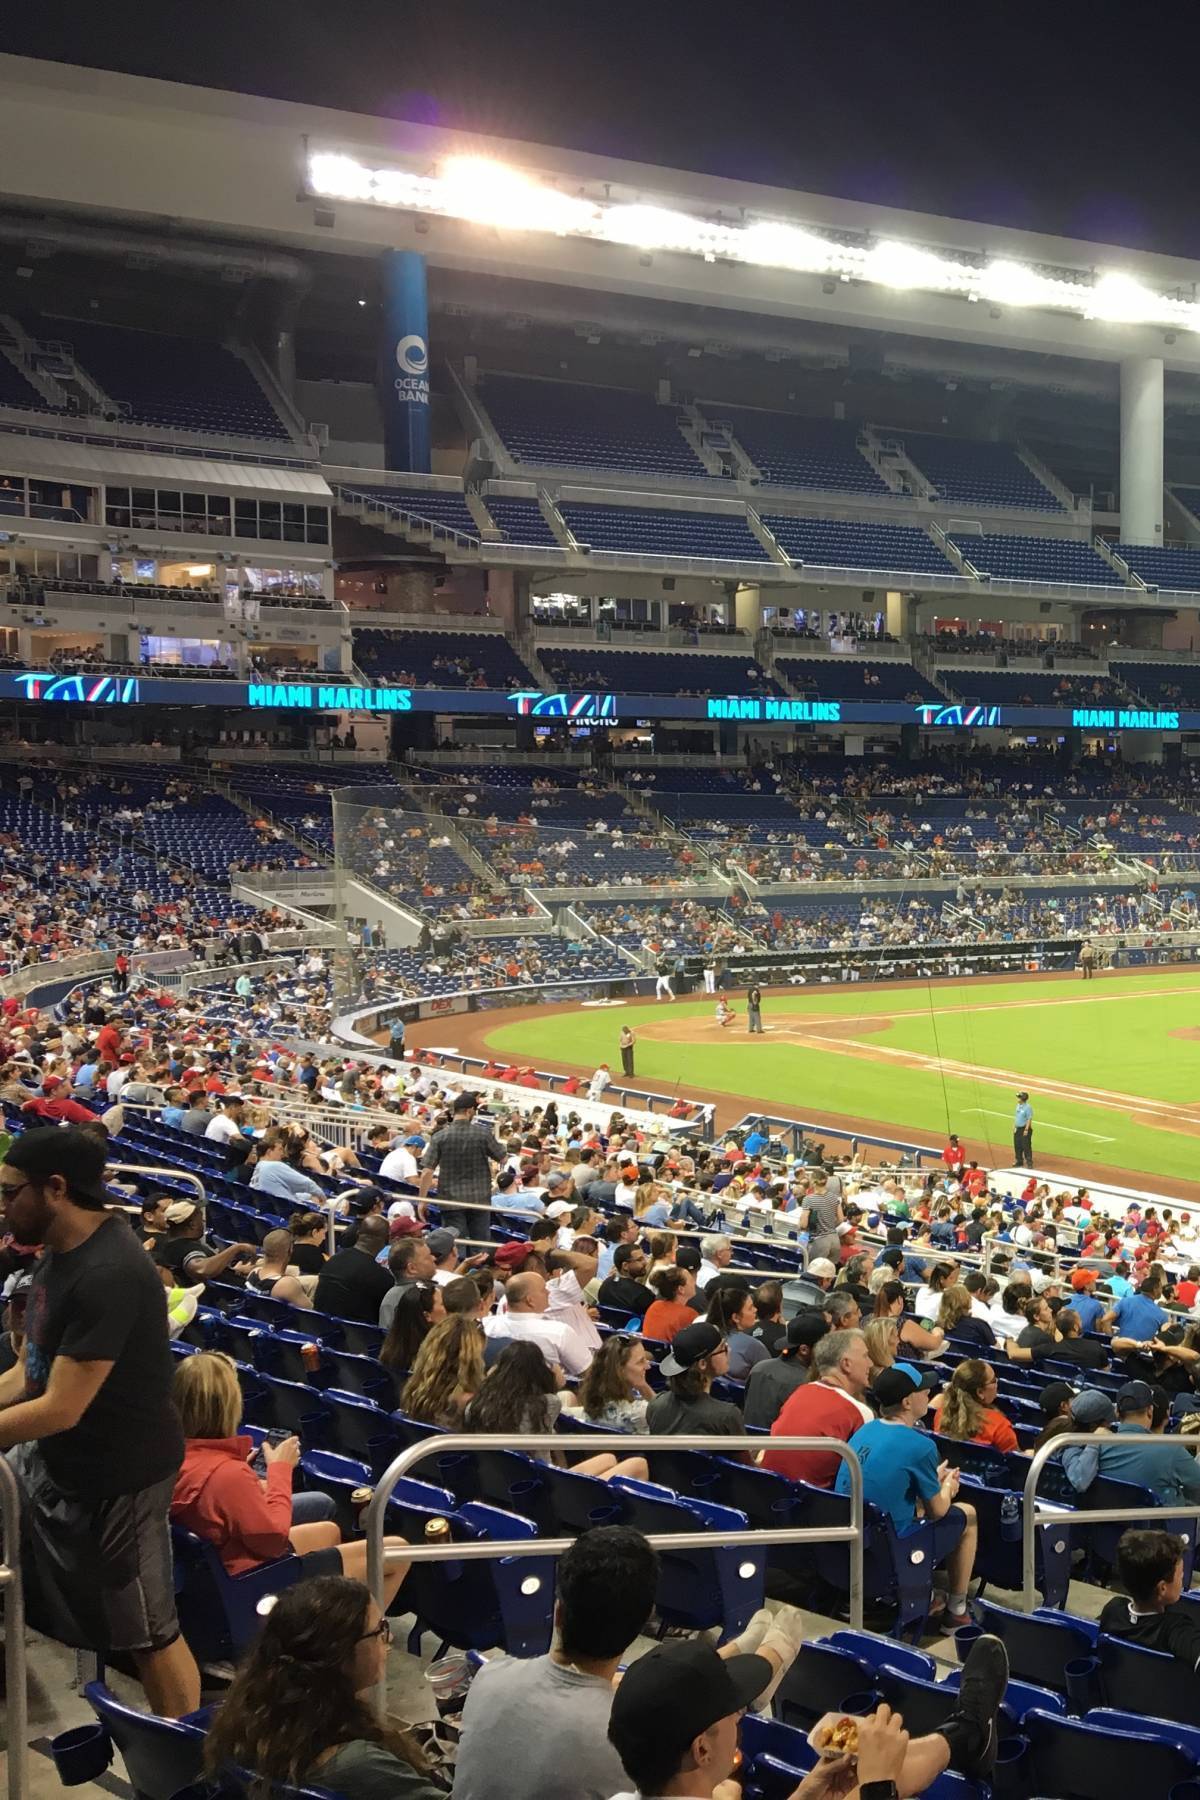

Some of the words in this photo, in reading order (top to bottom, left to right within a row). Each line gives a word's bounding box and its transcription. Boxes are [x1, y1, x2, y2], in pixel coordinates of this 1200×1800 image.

[248, 684, 313, 708] MIAMI
[318, 687, 412, 711] MARLINS
[707, 699, 760, 719] MIAMI
[765, 701, 841, 721] MARLINS
[1072, 709, 1116, 728] MIAMI
[1118, 711, 1180, 729] MARLINS
